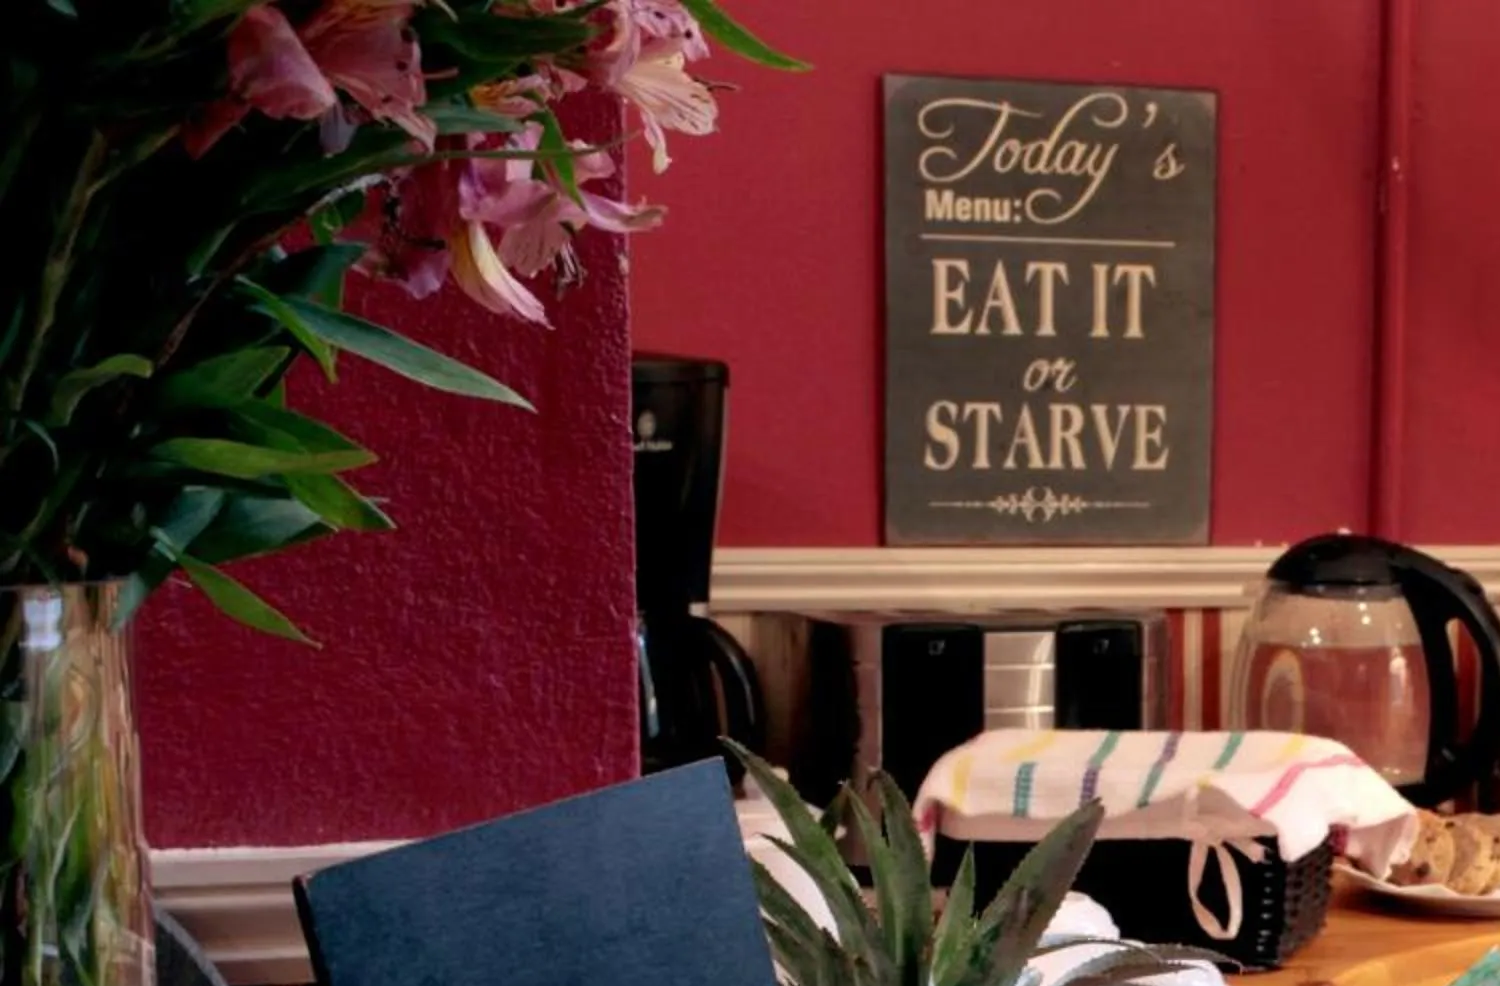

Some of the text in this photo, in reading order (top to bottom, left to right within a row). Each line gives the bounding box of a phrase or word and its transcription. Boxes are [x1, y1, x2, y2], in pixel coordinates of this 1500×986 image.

[918, 92, 1185, 225] Today's
[924, 190, 1022, 223] Menu:
[930, 258, 1158, 339] EAT IT
[1022, 358, 1077, 392] or
[923, 400, 1170, 472] STARVE
